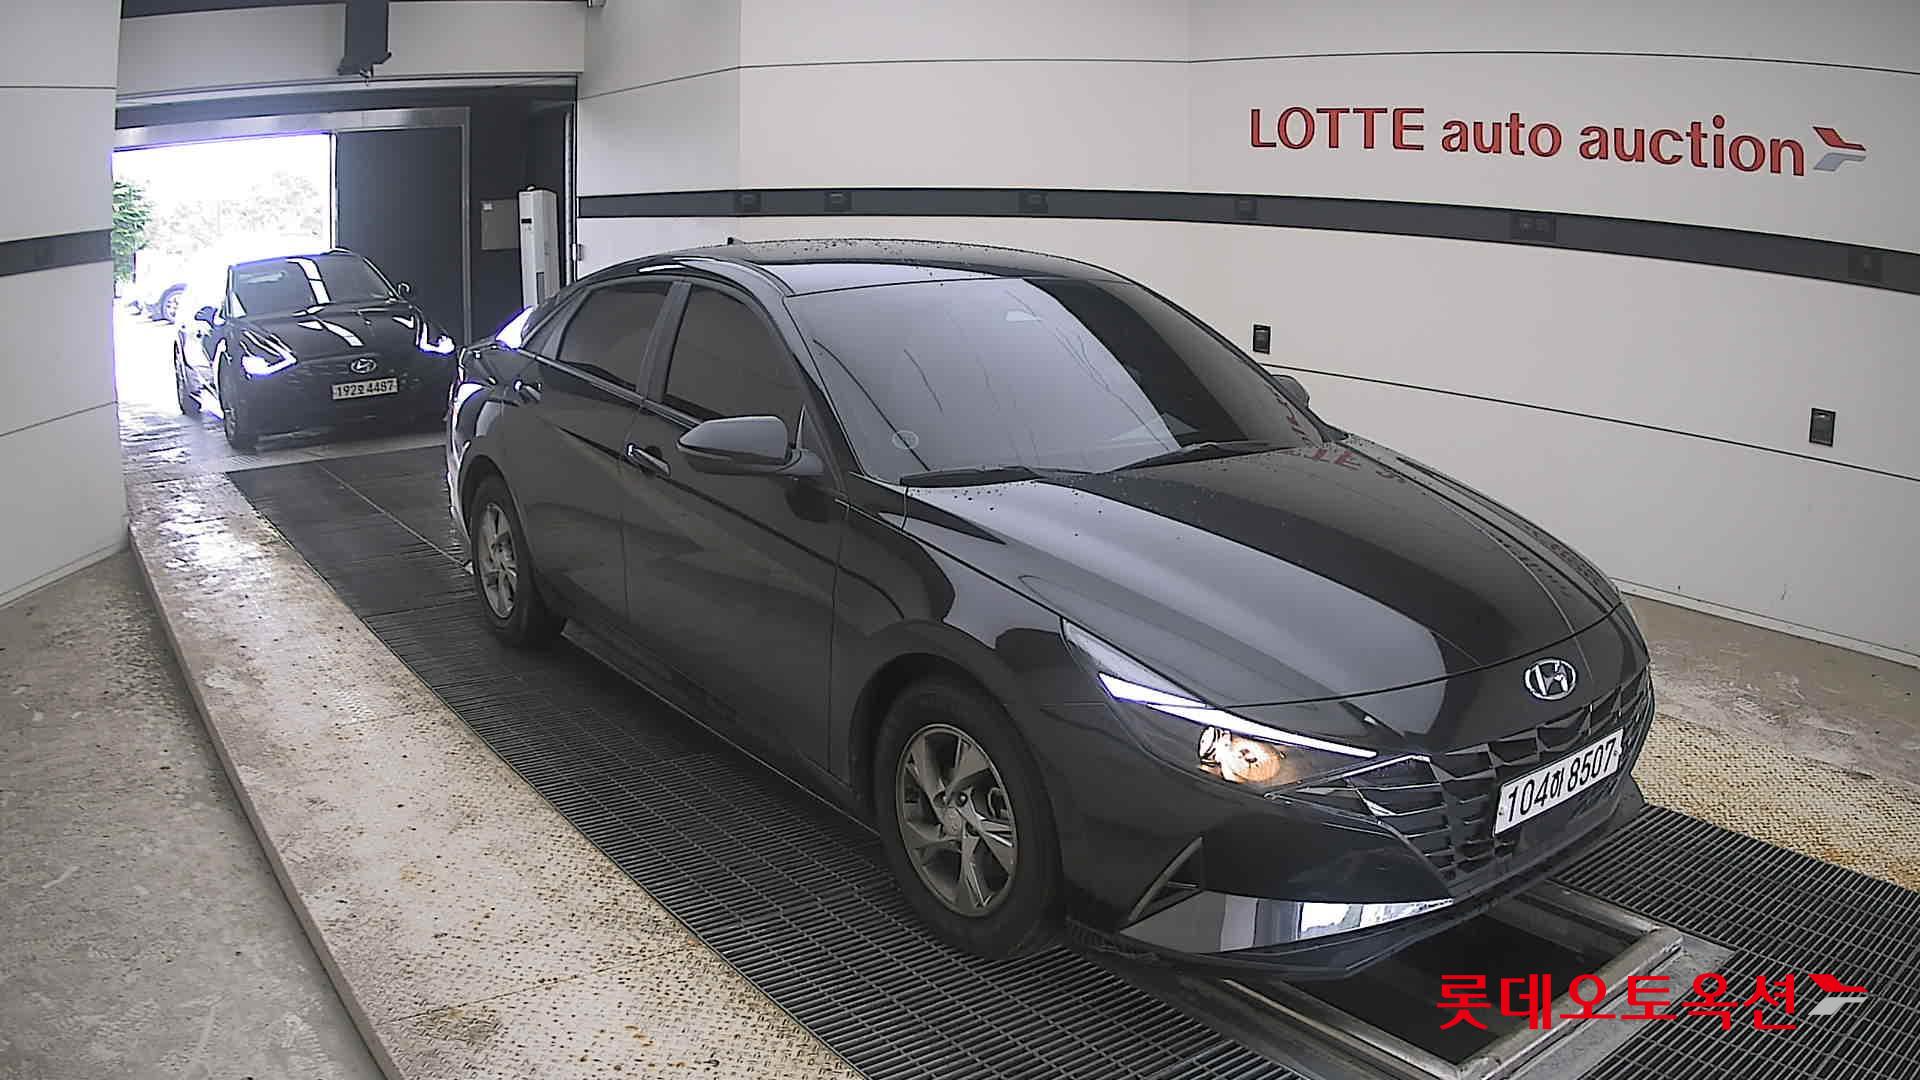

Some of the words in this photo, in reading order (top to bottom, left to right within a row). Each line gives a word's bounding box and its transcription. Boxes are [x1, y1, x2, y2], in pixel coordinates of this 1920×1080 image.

[1250, 107, 1425, 151] LOTTE
[1441, 112, 1562, 157] auto
[1579, 115, 1806, 176] auction
[1567, 737, 1617, 792] 8507
